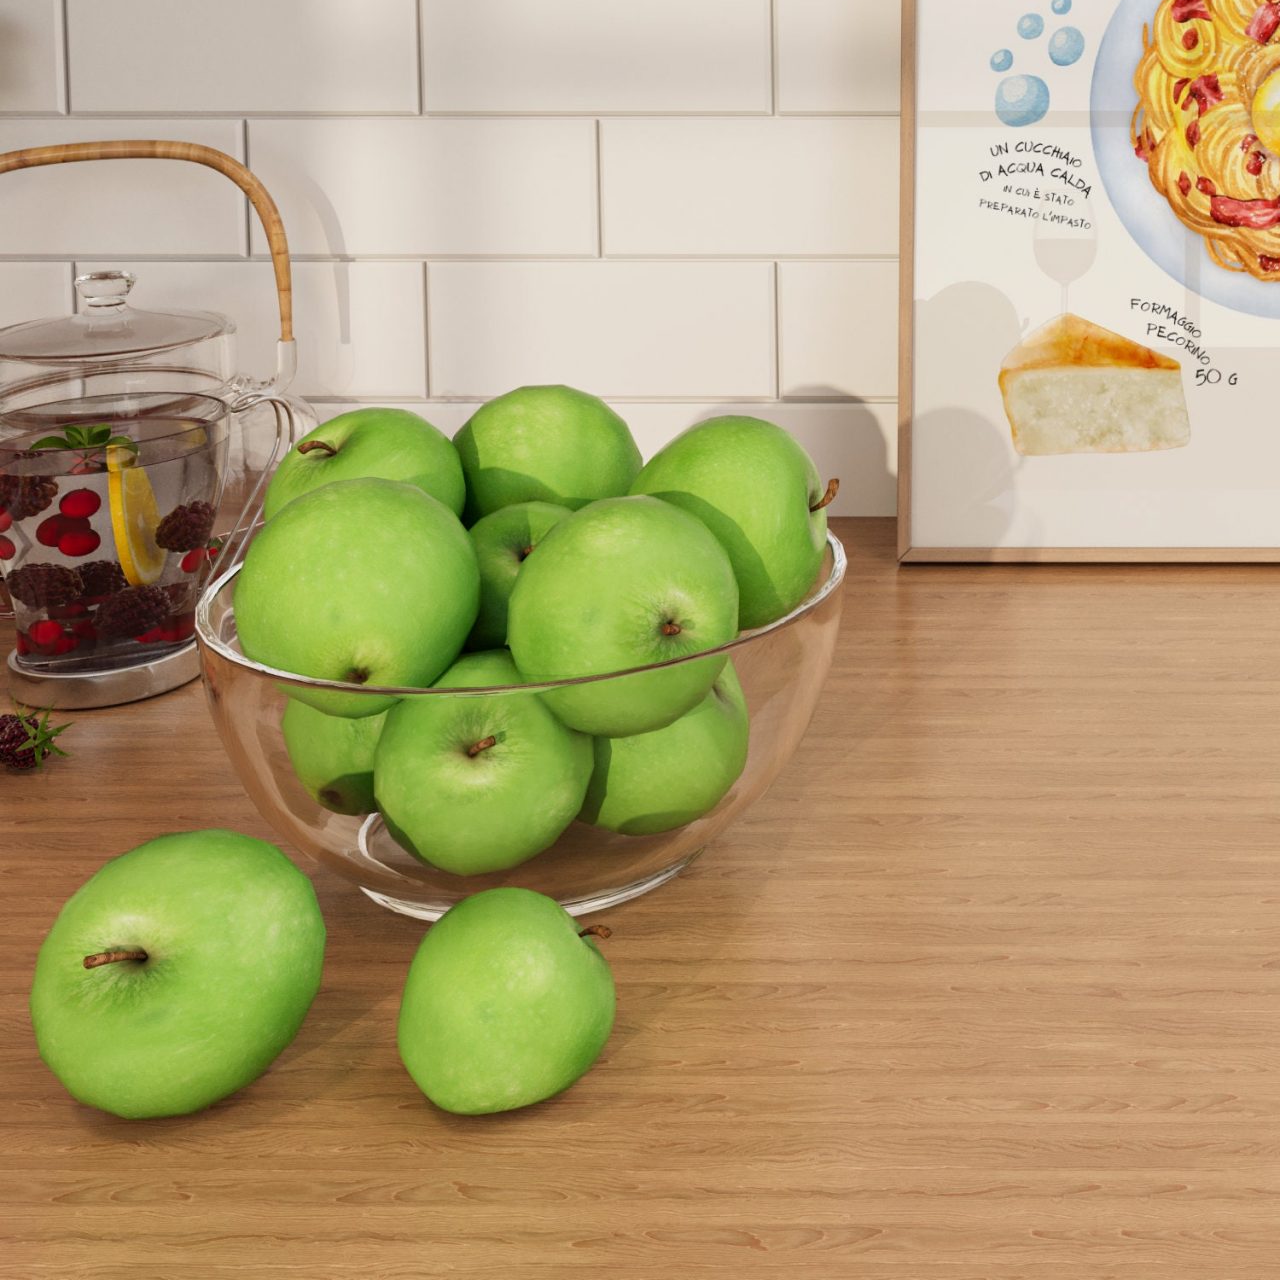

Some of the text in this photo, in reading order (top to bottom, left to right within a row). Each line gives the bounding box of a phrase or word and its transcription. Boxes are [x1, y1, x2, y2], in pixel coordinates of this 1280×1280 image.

[990, 141, 1082, 168] UN CUCCHIAIO
[979, 162, 1092, 199] DI ACQUA CALDA
[1003, 185, 1012, 193] IN
[1015, 188, 1030, 197] CUI
[1044, 192, 1075, 206] STATO
[979, 198, 1091, 230] PREPARATO L'IMPASTO
[1130, 298, 1202, 338] FORMAGGIO
[1146, 323, 1210, 365] PECORINO
[1195, 368, 1238, 386] 50 G
